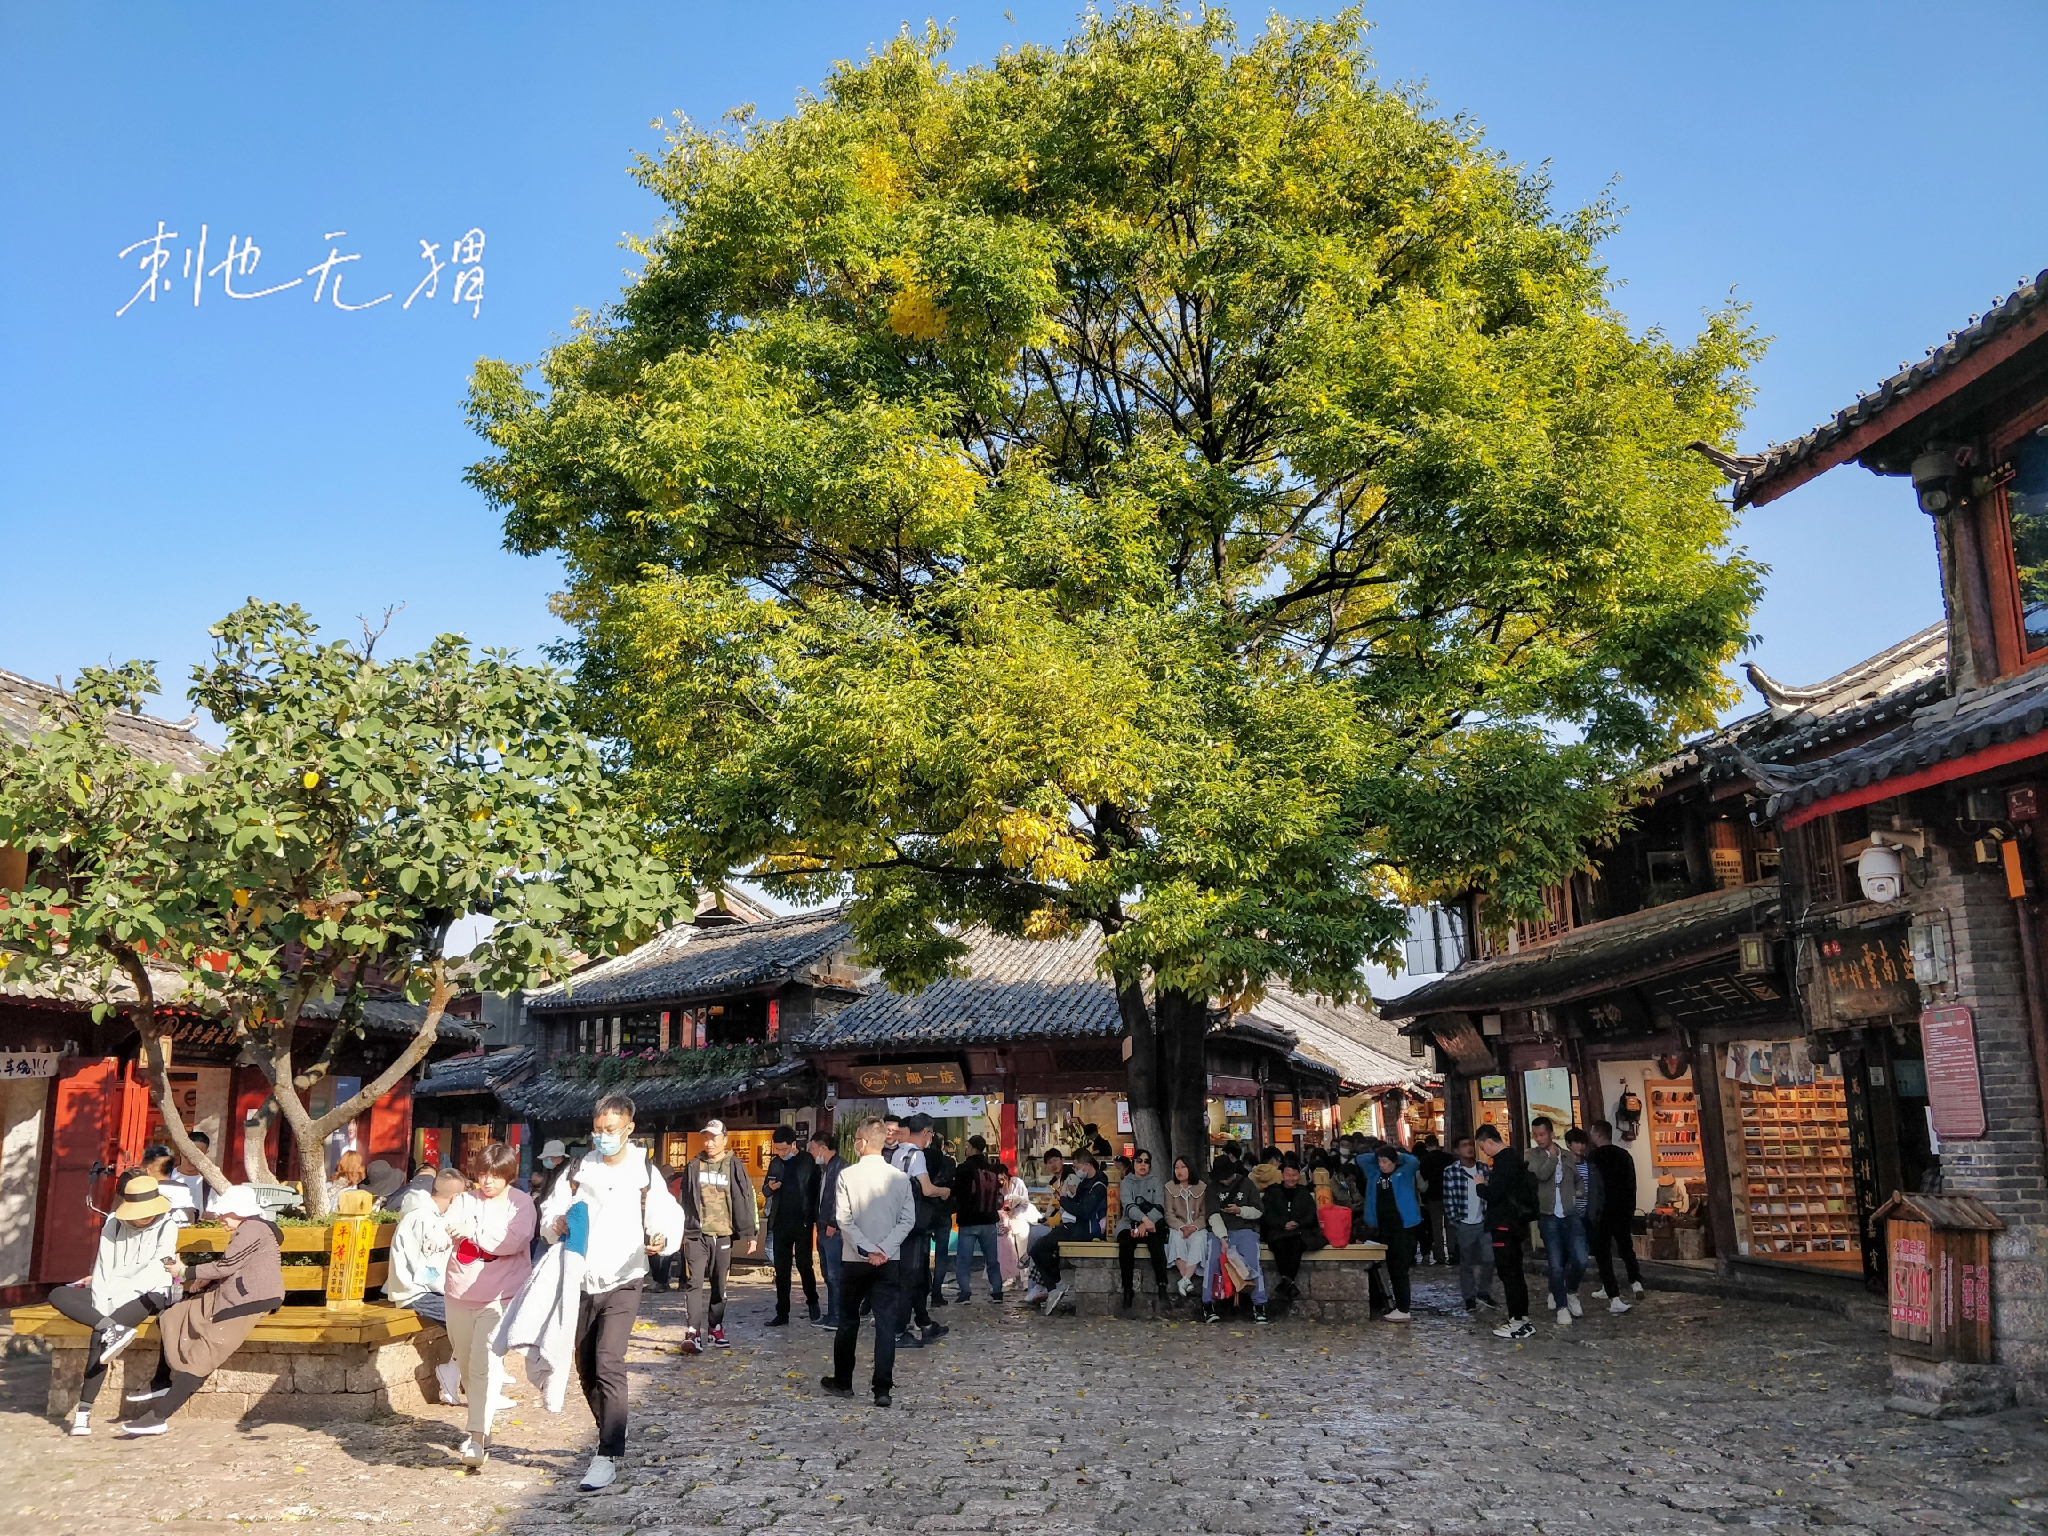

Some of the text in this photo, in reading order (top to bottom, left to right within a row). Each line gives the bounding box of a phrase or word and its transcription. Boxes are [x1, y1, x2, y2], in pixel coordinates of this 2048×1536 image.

[906, 1070, 956, 1085] 椰一族
[333, 1226, 348, 1260] 平等
[358, 1226, 367, 1258] 自由
[1909, 1267, 1928, 1308] 119
[1962, 1265, 1975, 1320] 严禁损坏
[1976, 1265, 1989, 1321] 消防设施
